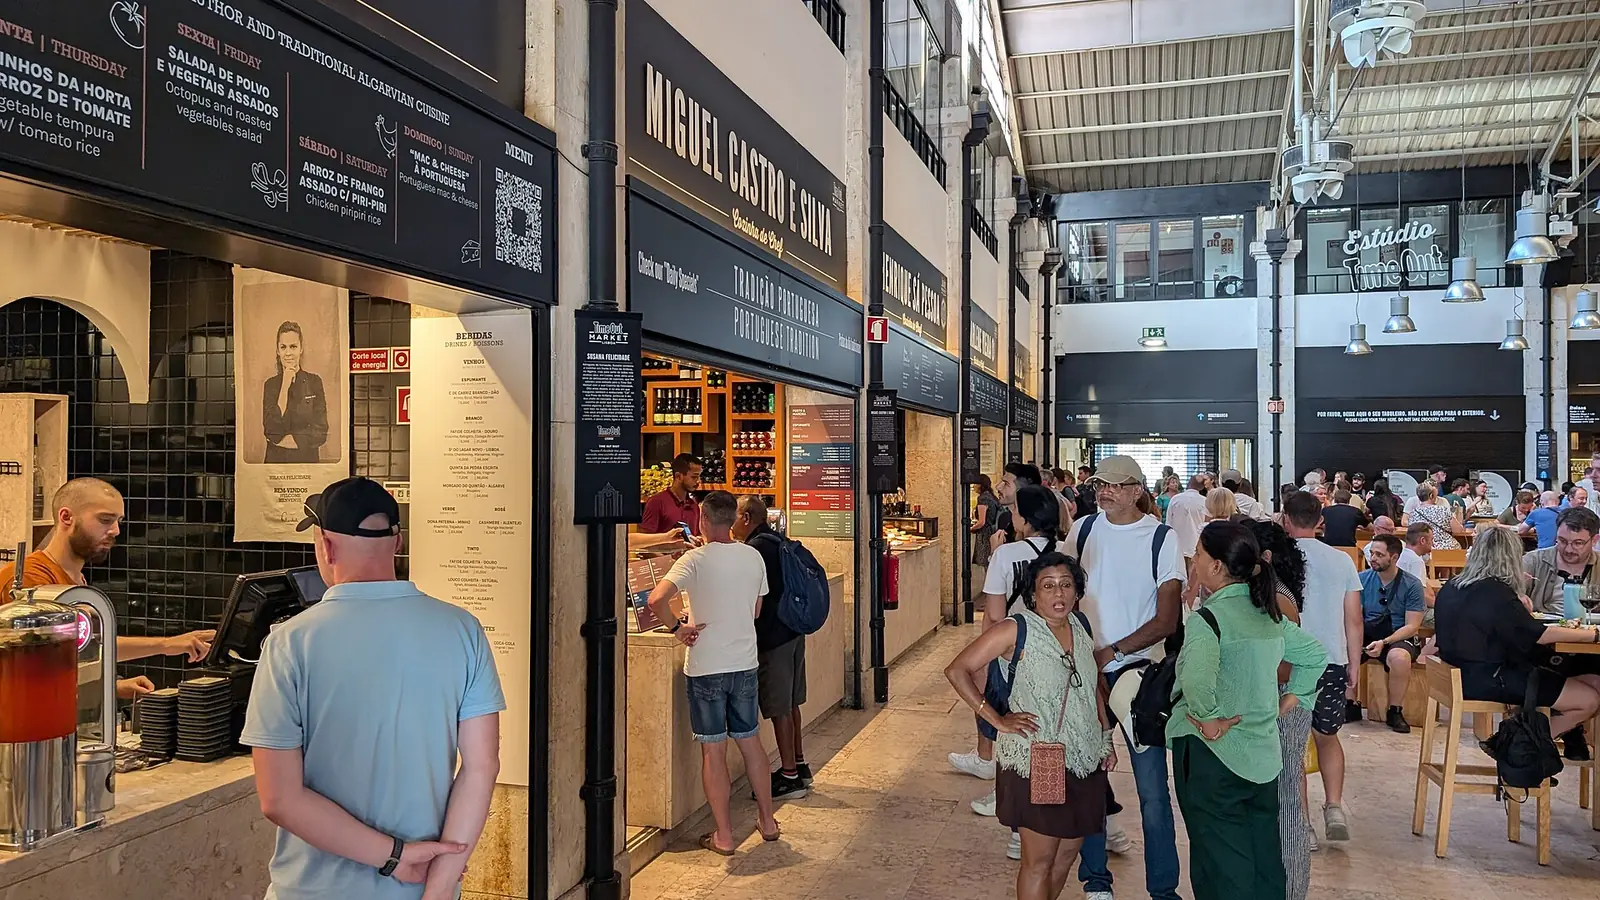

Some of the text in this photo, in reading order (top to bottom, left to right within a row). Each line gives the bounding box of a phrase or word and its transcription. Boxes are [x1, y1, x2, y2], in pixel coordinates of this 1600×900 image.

[0, 18, 128, 79] NTA THURSDAY
[177, 22, 262, 71] SEXTA FRIDAY
[192, 0, 450, 126] THOR AND TRADITIONAL ALGARVIAN CUISINE
[0, 51, 132, 110] INHOS DA HORTA
[157, 58, 279, 119] E VEGETAIS ASSADOS
[168, 45, 270, 99] SALADA DE POLVO
[0, 72, 131, 129] RROZ DE TOMATE
[0, 96, 115, 143] getable tempura
[165, 80, 272, 132] Octopus and roasted
[18, 121, 72, 149] tomato
[75, 138, 101, 158] rice
[176, 104, 262, 145] vegetables salad
[403, 126, 474, 165] DOMINGO SUNDAY
[299, 136, 388, 178] SÁBADO SATURDAY
[431, 159, 439, 170] &
[505, 141, 533, 166] MENU
[646, 62, 832, 257] MIGUEL CASTRO E SILVA
[299, 175, 387, 214] ASSADO C/ PIRI-PIRI
[302, 161, 385, 199] ARROZ DE FRANGO
[399, 172, 479, 210] Portuguese mac & cheese
[413, 160, 466, 193] À PORTUGUESA
[305, 194, 382, 226] Chicken piripiri rice
[732, 207, 784, 259] Cozinha de Chef
[1343, 220, 1437, 255] Estúdio
[638, 250, 655, 279] Check
[654, 262, 664, 281] our
[733, 265, 820, 328] TRADIÇÃO PORTUGUESA
[921, 282, 941, 326] PESSOA
[456, 332, 493, 340] BEBIDAS
[734, 306, 784, 350] PORTUGUESE
[786, 326, 820, 361] TRADITION
[362, 361, 386, 370] energia
